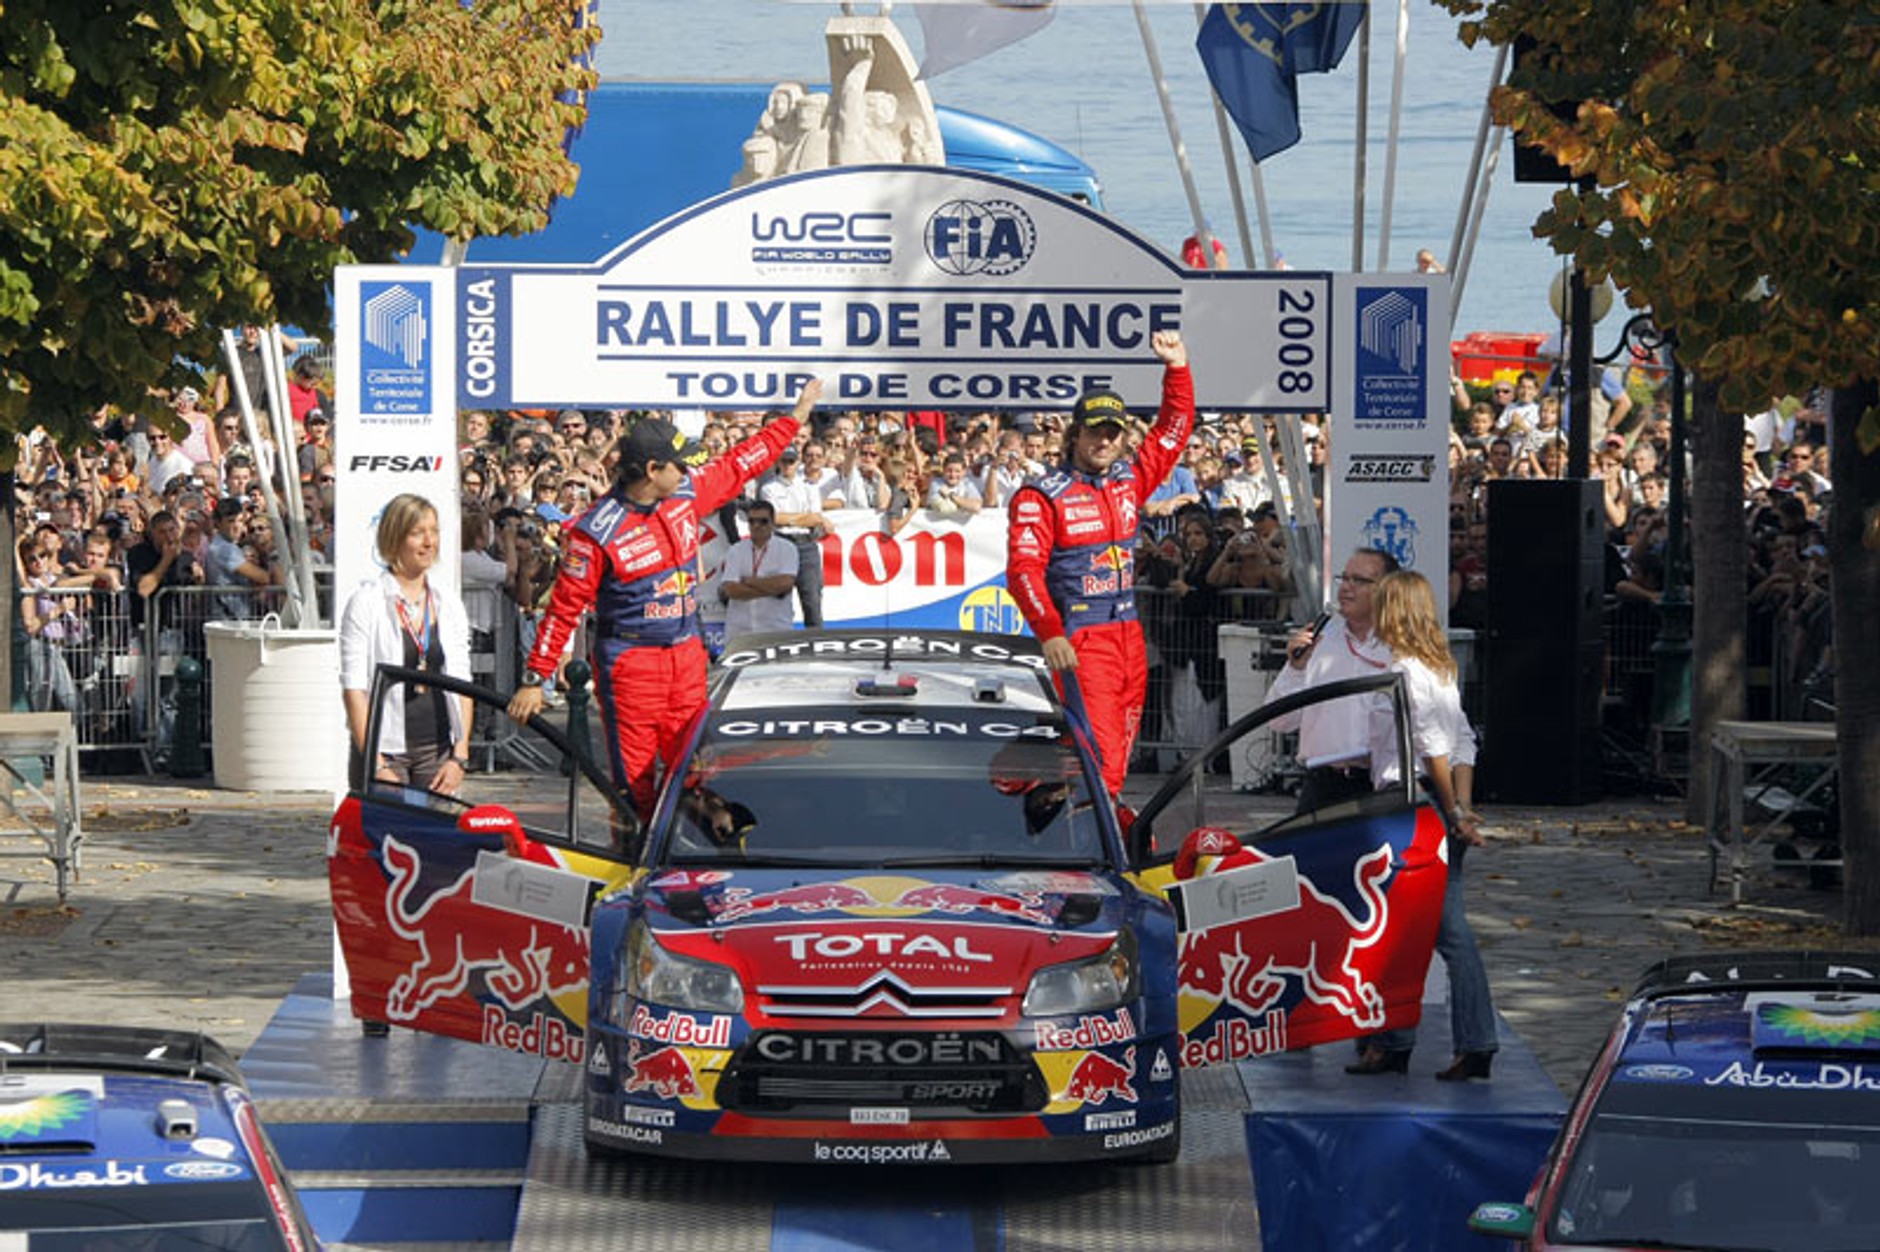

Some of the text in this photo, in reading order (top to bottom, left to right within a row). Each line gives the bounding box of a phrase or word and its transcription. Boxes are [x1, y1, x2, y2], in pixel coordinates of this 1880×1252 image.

[751, 211, 892, 243] WRC
[781, 250, 836, 261] WORLD
[838, 250, 891, 261] RALLY
[466, 278, 496, 398] CORSICA
[597, 300, 1182, 349] RALLYE DE FRANCE
[1278, 289, 1315, 394] 2008
[839, 373, 908, 399] DE
[373, 401, 419, 412] de Corse
[1367, 406, 1414, 417] de Corse
[349, 455, 432, 472] FFSA
[722, 636, 961, 667] CITROËN
[971, 644, 1048, 670] C4
[718, 718, 1062, 739] CITROËN C4
[468, 816, 509, 827] TOTAL
[773, 932, 994, 962] TOTAL
[482, 1003, 543, 1055] Red
[629, 1004, 732, 1047] Red Bull
[1034, 1007, 1136, 1050] Red Bull
[1227, 1007, 1287, 1060] Bull
[757, 1033, 1000, 1064] CITROËN
[1703, 1060, 1819, 1088] Abu
[911, 1081, 998, 1099] SPORT
[814, 1141, 929, 1164] le coq sportif
